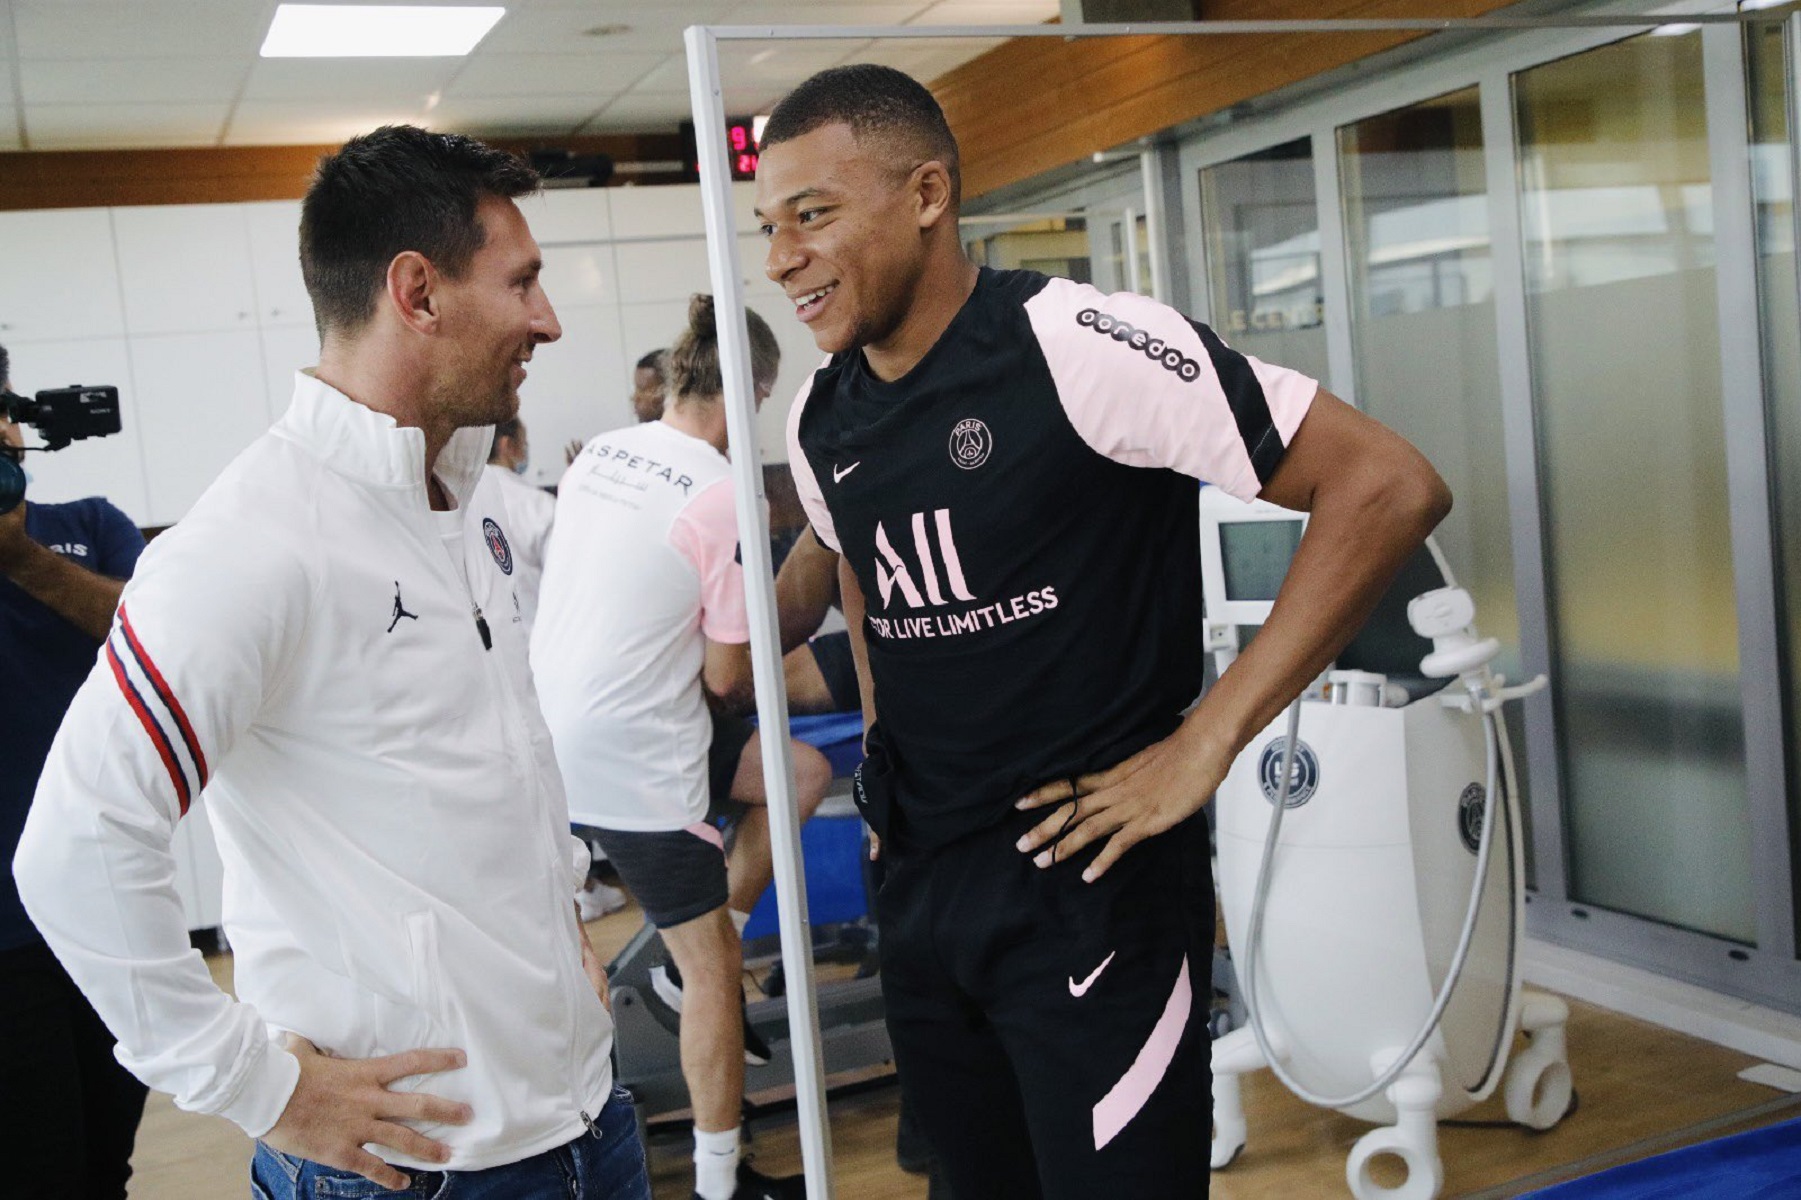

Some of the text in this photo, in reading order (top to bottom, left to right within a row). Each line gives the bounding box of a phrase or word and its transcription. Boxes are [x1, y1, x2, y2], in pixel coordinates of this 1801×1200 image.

[1076, 308, 1200, 382] ooredoo
[955, 420, 982, 437] PARIS
[587, 443, 694, 497] ASPETAR
[893, 617, 936, 639] LIVE
[936, 584, 1059, 637] LIMITLESS
